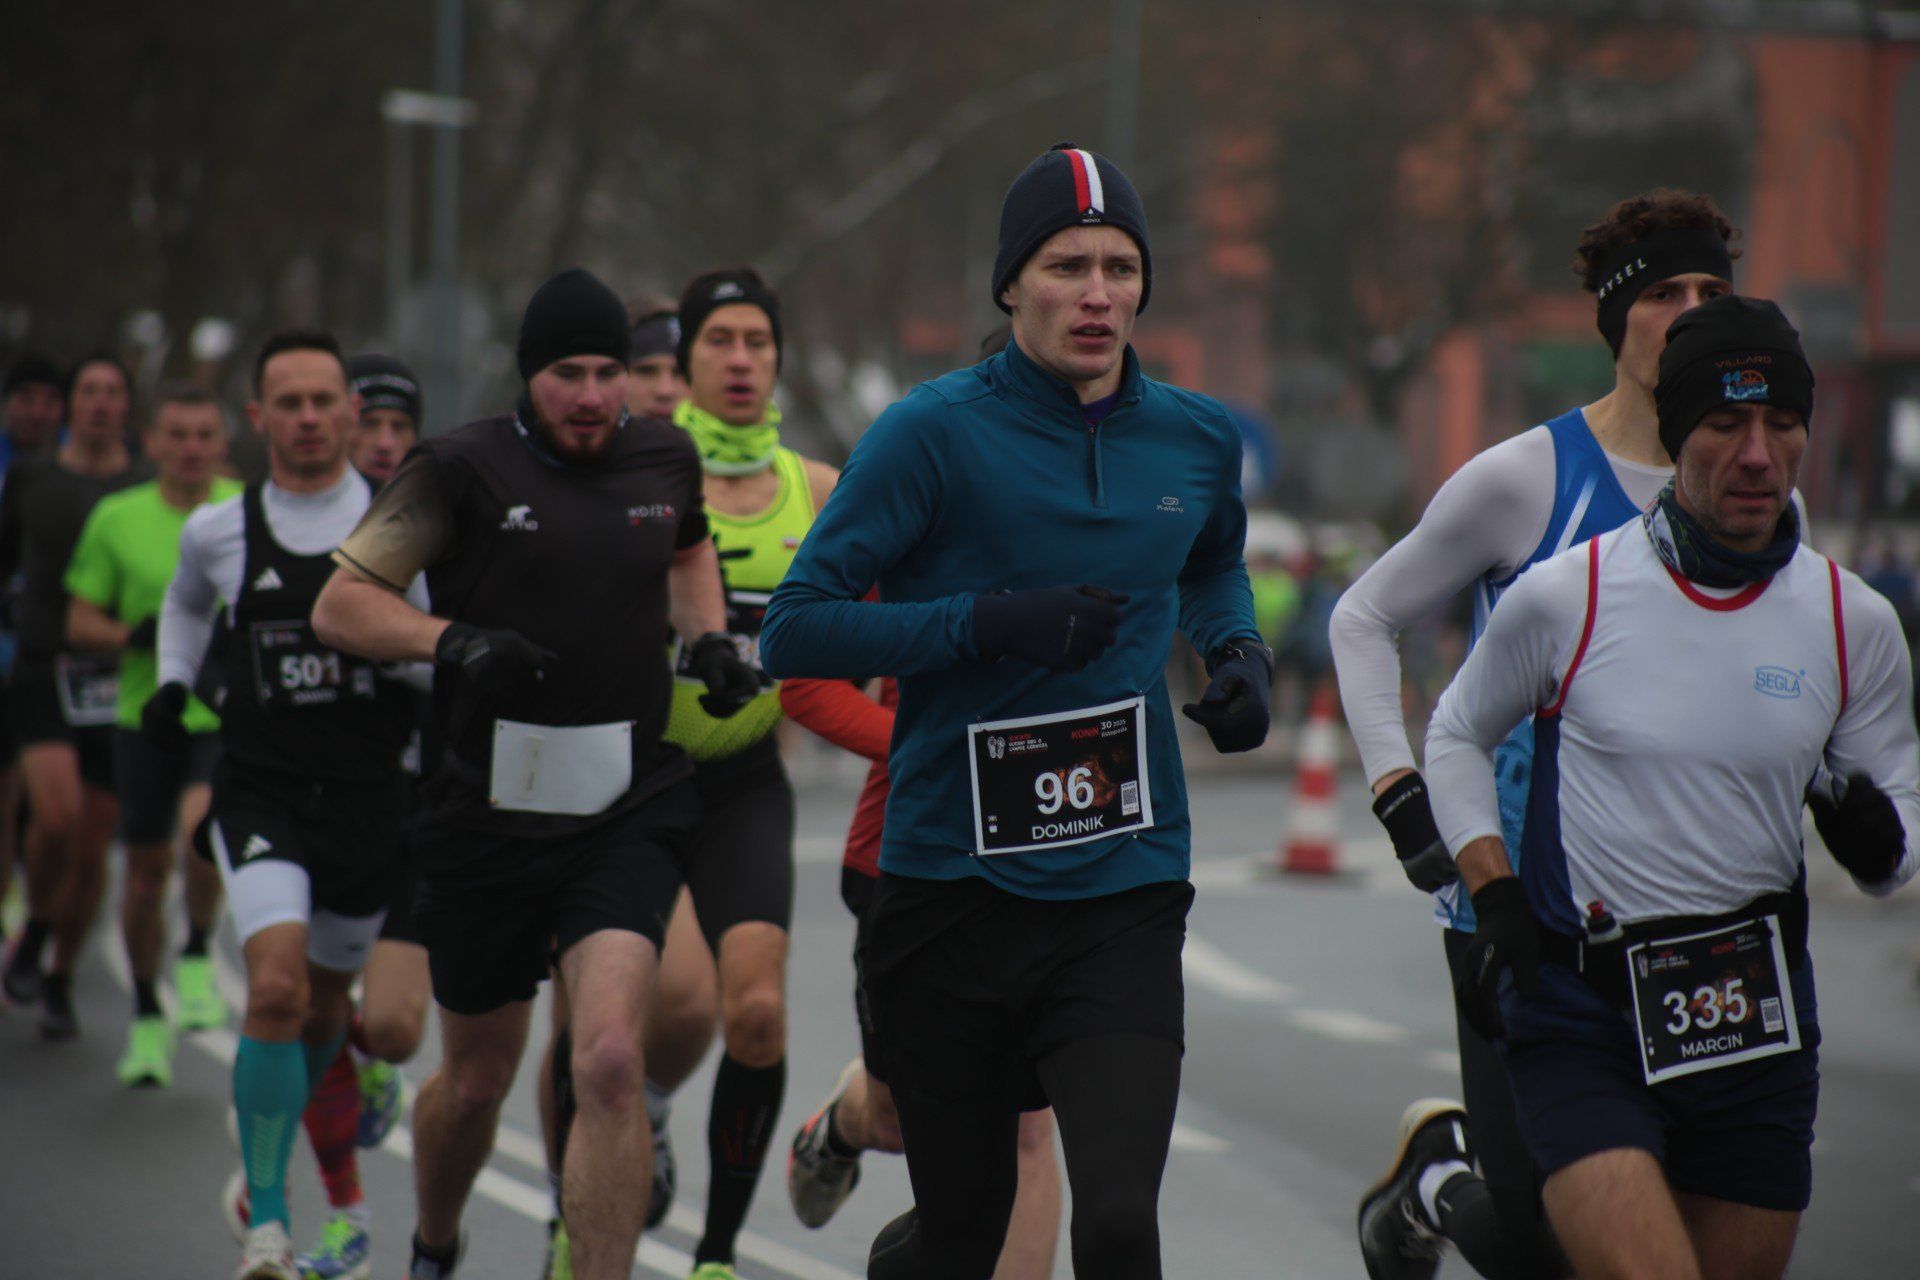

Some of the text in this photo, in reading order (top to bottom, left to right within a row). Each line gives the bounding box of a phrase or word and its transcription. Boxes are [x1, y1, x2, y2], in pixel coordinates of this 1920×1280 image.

[1714, 354, 1773, 368] VILLARD
[281, 653, 342, 689] 501
[1756, 670, 1801, 693] SEGLA
[1071, 726, 1100, 739] KONIN
[1100, 720, 1112, 730] 30
[1034, 766, 1095, 815] 96
[1032, 814, 1104, 840] DOMINIK
[1663, 978, 1747, 1035] 335
[1681, 1032, 1743, 1058] MARCIN
